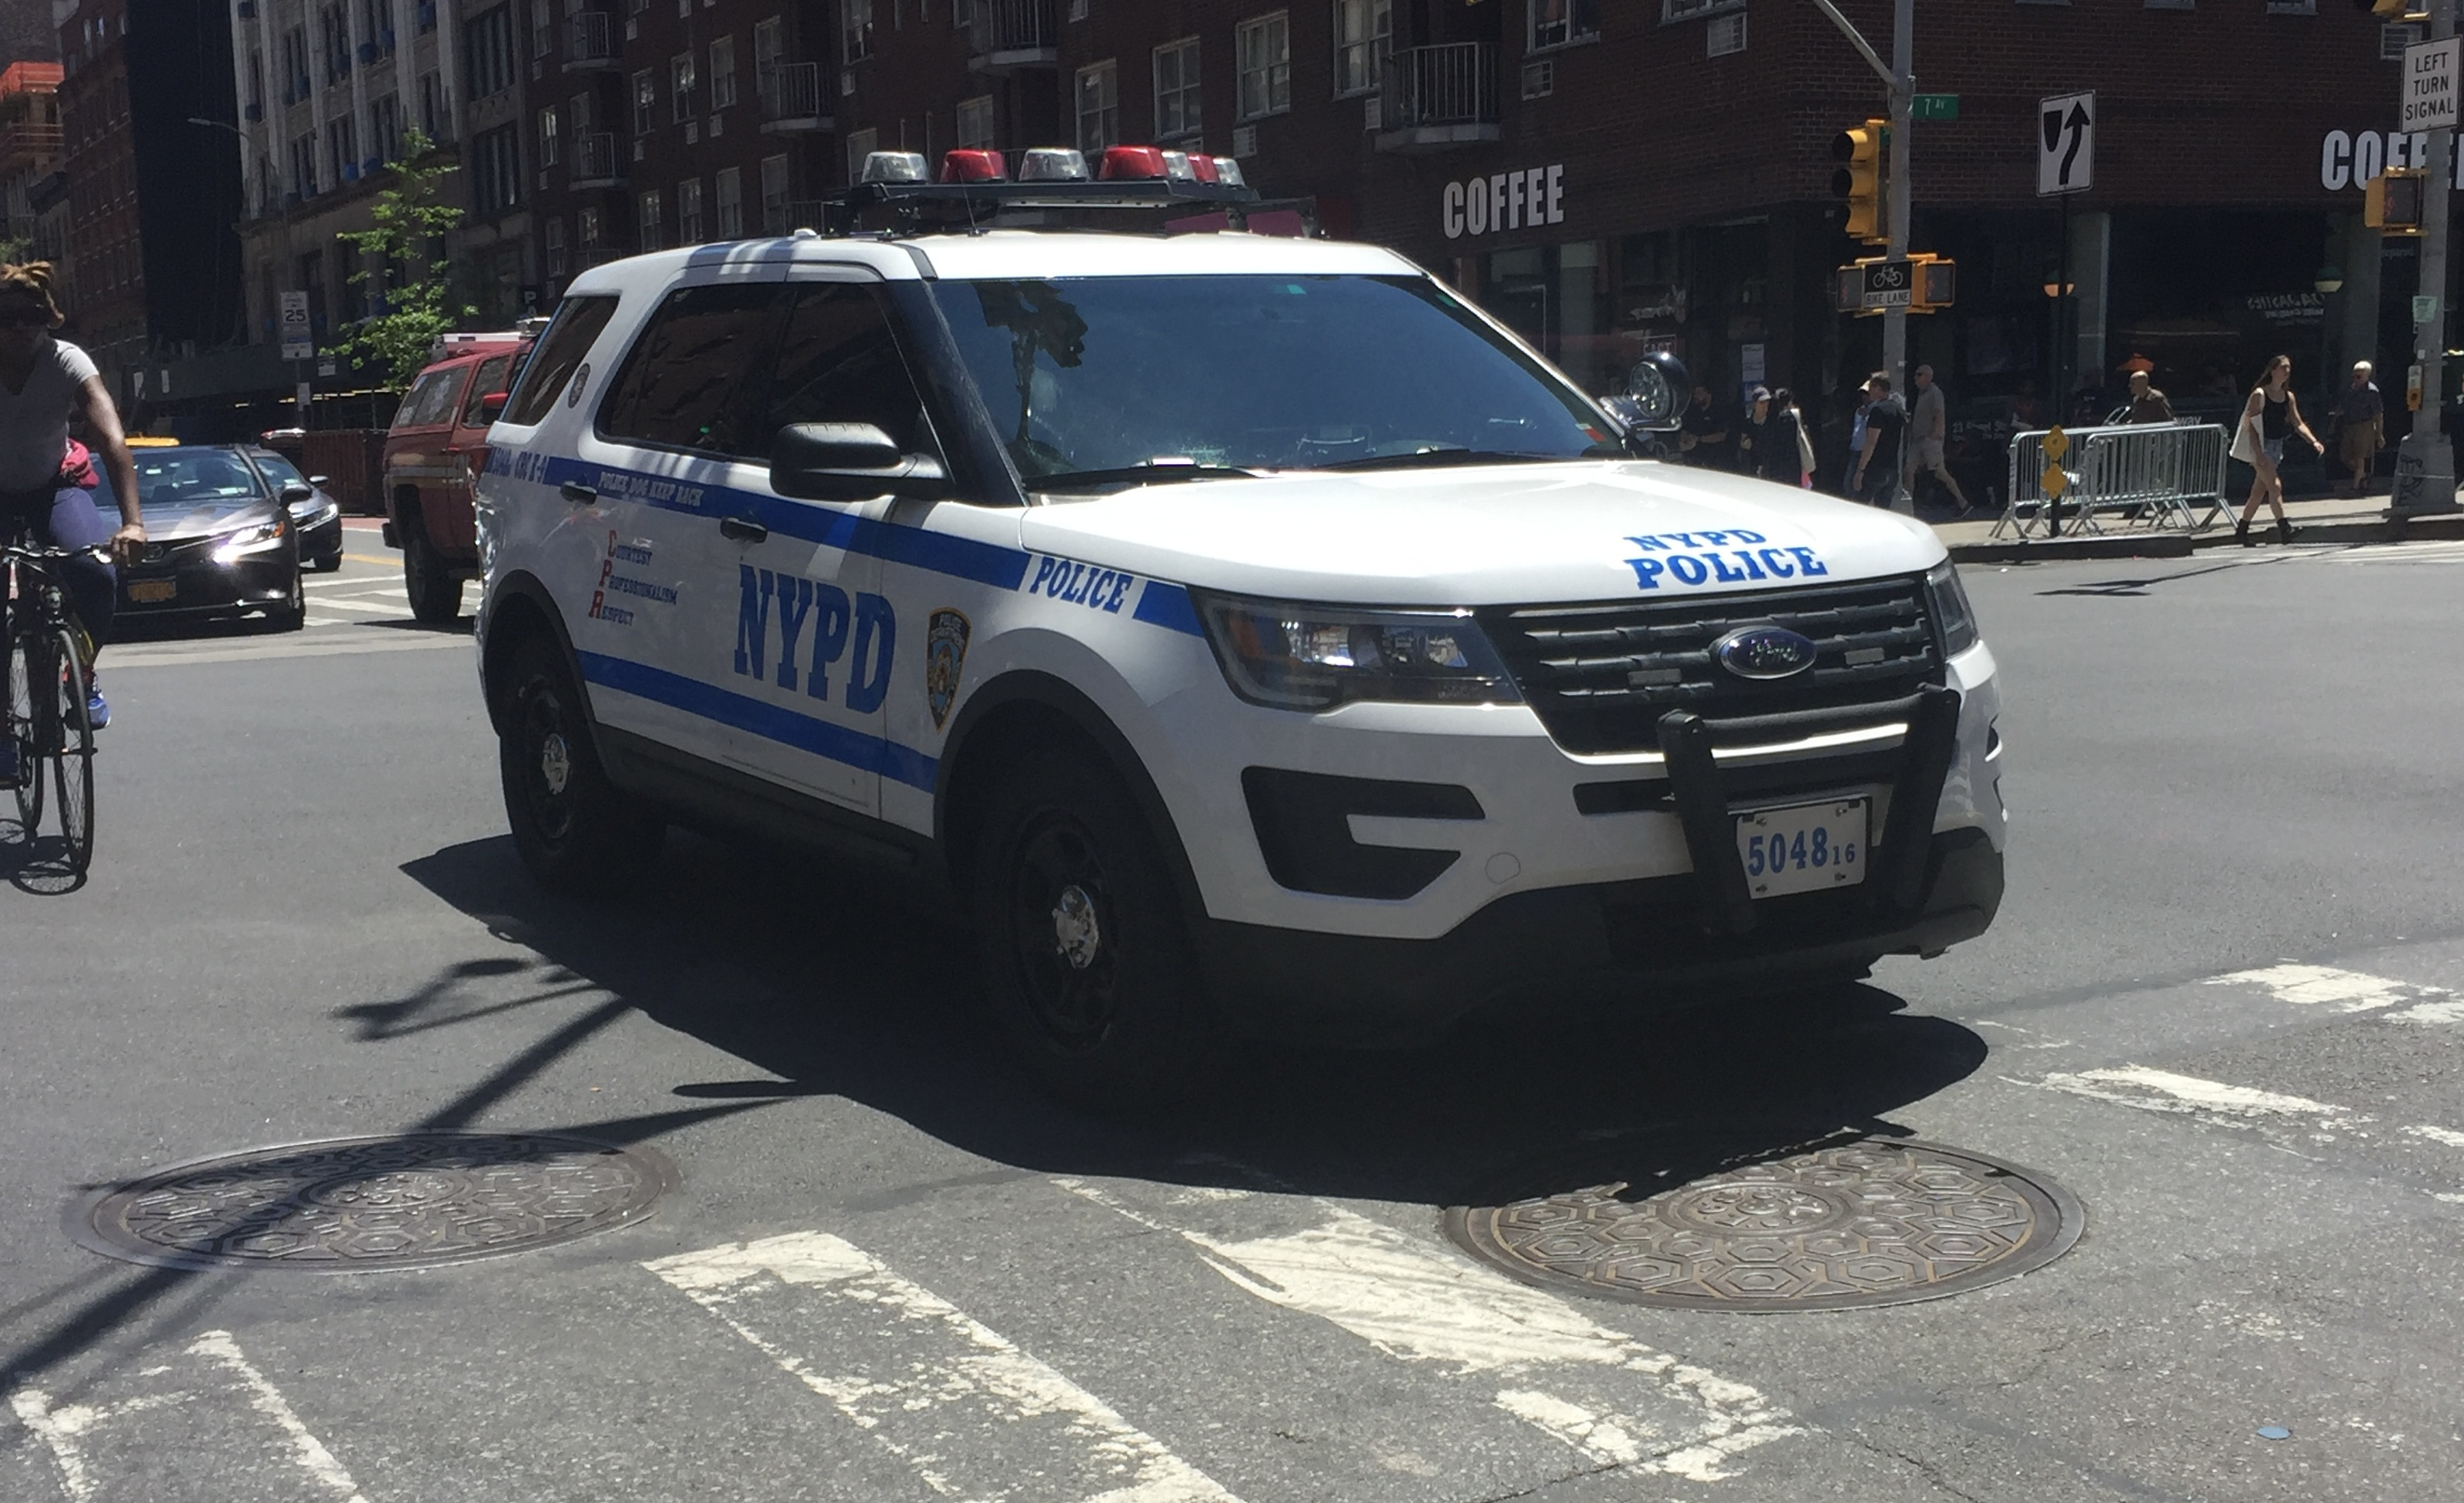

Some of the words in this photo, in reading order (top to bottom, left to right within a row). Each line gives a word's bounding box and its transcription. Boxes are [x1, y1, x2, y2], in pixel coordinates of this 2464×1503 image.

[2416, 52, 2449, 74] LEFT
[2413, 75, 2449, 96] TURN
[1924, 98, 1931, 115] 7
[2405, 97, 2454, 121] SIGNAL
[2321, 129, 2464, 191] COFF
[1443, 164, 1564, 239] COFFEE
[1866, 293, 1884, 306] BIKE
[1887, 291, 1909, 304] LANE
[286, 309, 306, 322] 25
[650, 480, 676, 501] KEEP
[1622, 529, 1767, 552] NYPD
[1623, 546, 1829, 590] POLICE
[1028, 556, 1135, 615] POLICE
[734, 563, 896, 714] NYPD
[1747, 826, 1829, 877] 5048
[1832, 843, 1856, 866] 16
